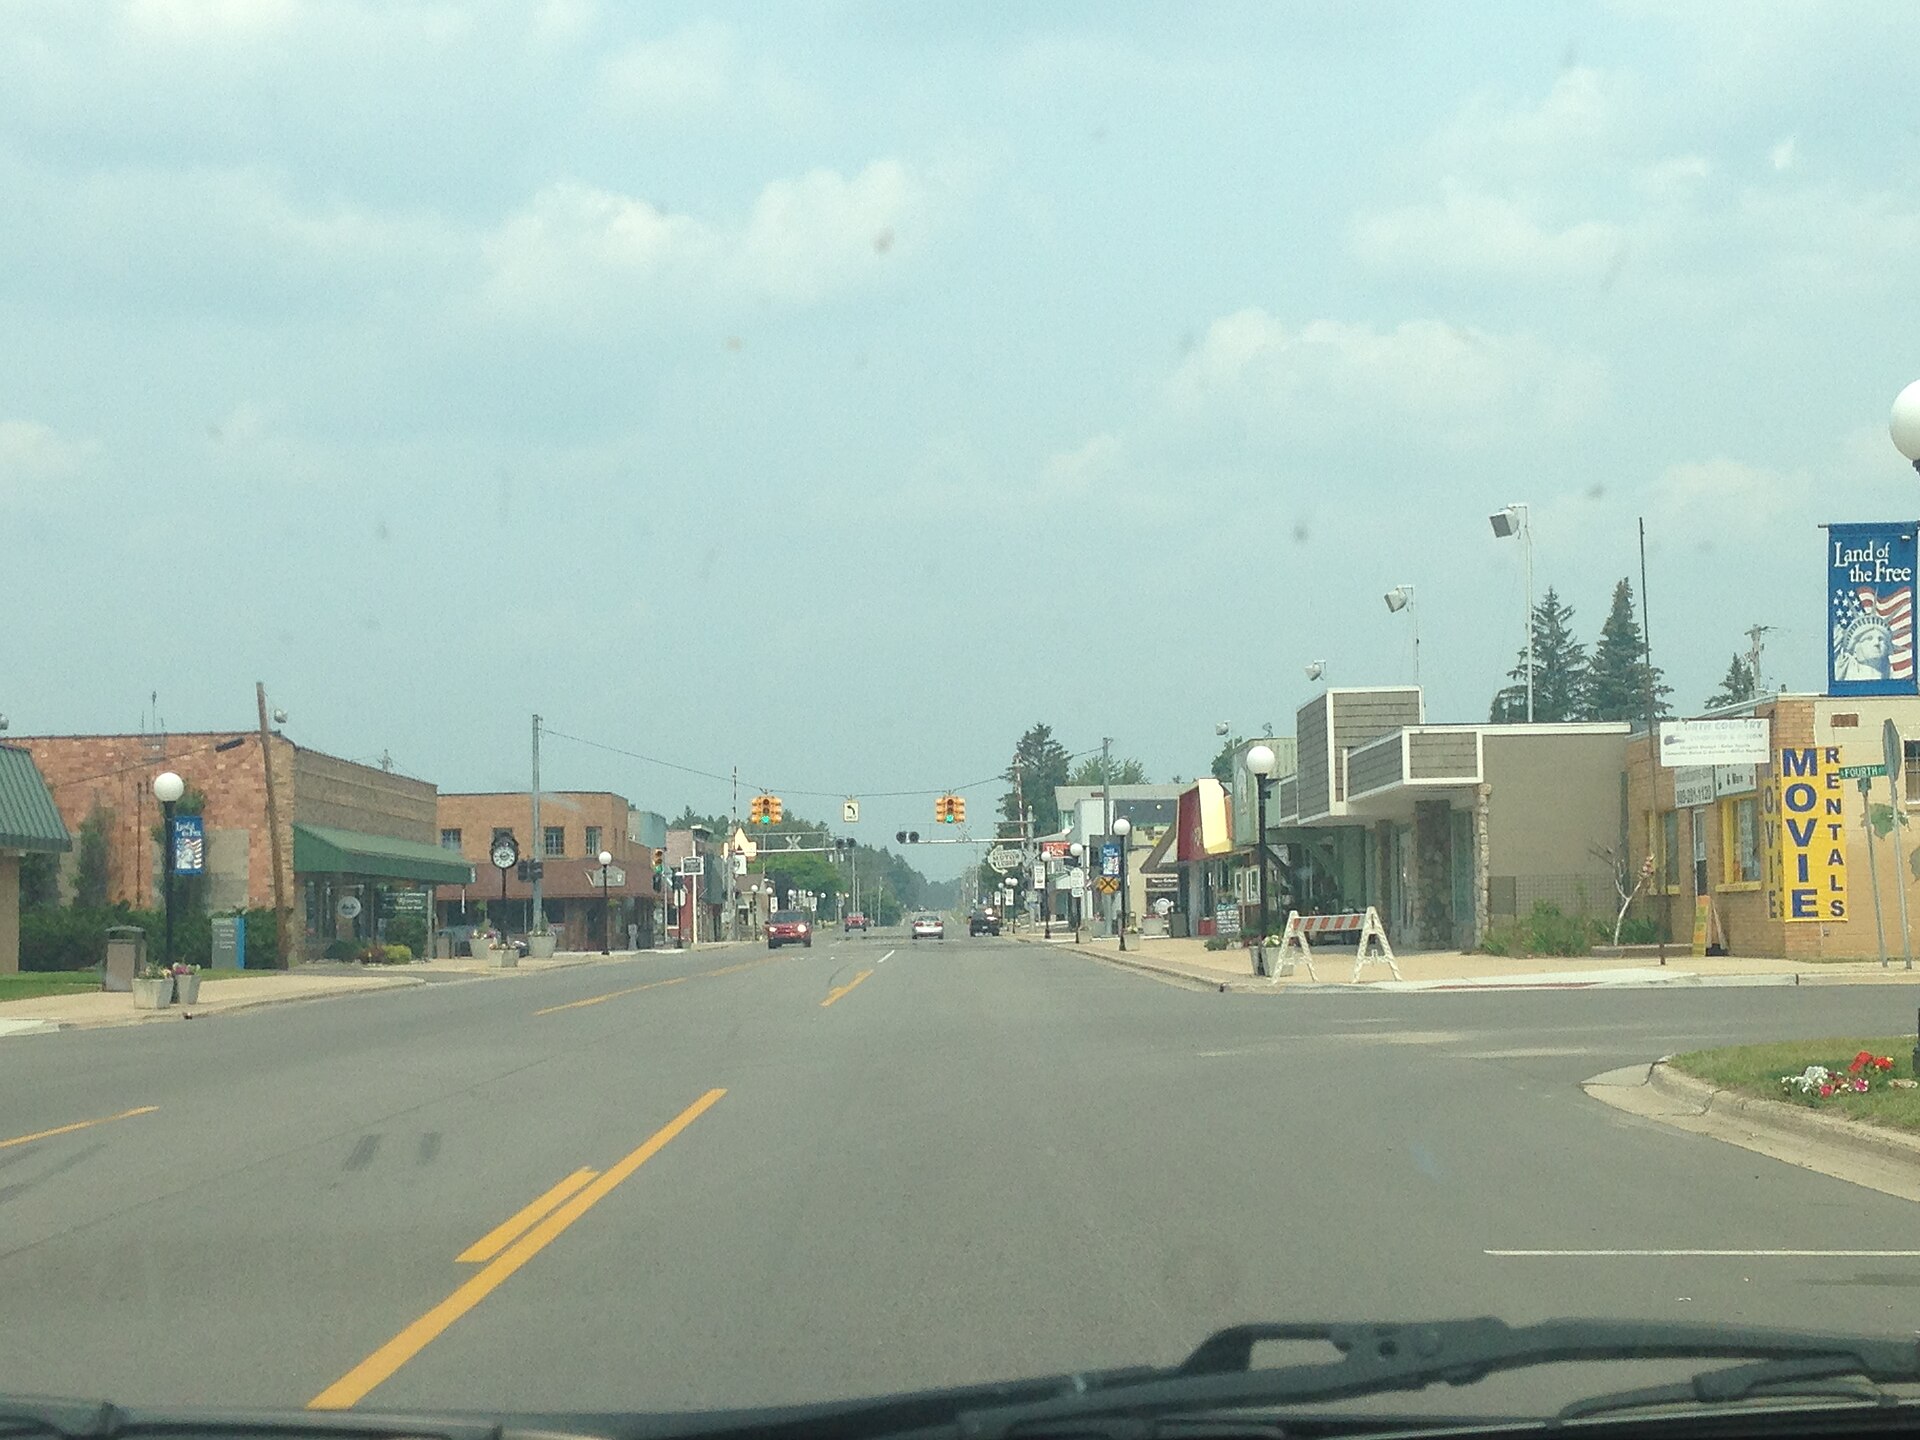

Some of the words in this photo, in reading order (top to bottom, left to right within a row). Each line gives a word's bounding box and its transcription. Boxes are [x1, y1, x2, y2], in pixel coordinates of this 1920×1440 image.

[1834, 540, 1873, 567] Land
[1876, 542, 1890, 558] of
[1849, 564, 1873, 582] the
[1874, 558, 1912, 582] Free
[1845, 765, 1878, 778] FOURTH
[1783, 748, 1818, 918] MOVIE
[1825, 747, 1845, 917] RENTALS
